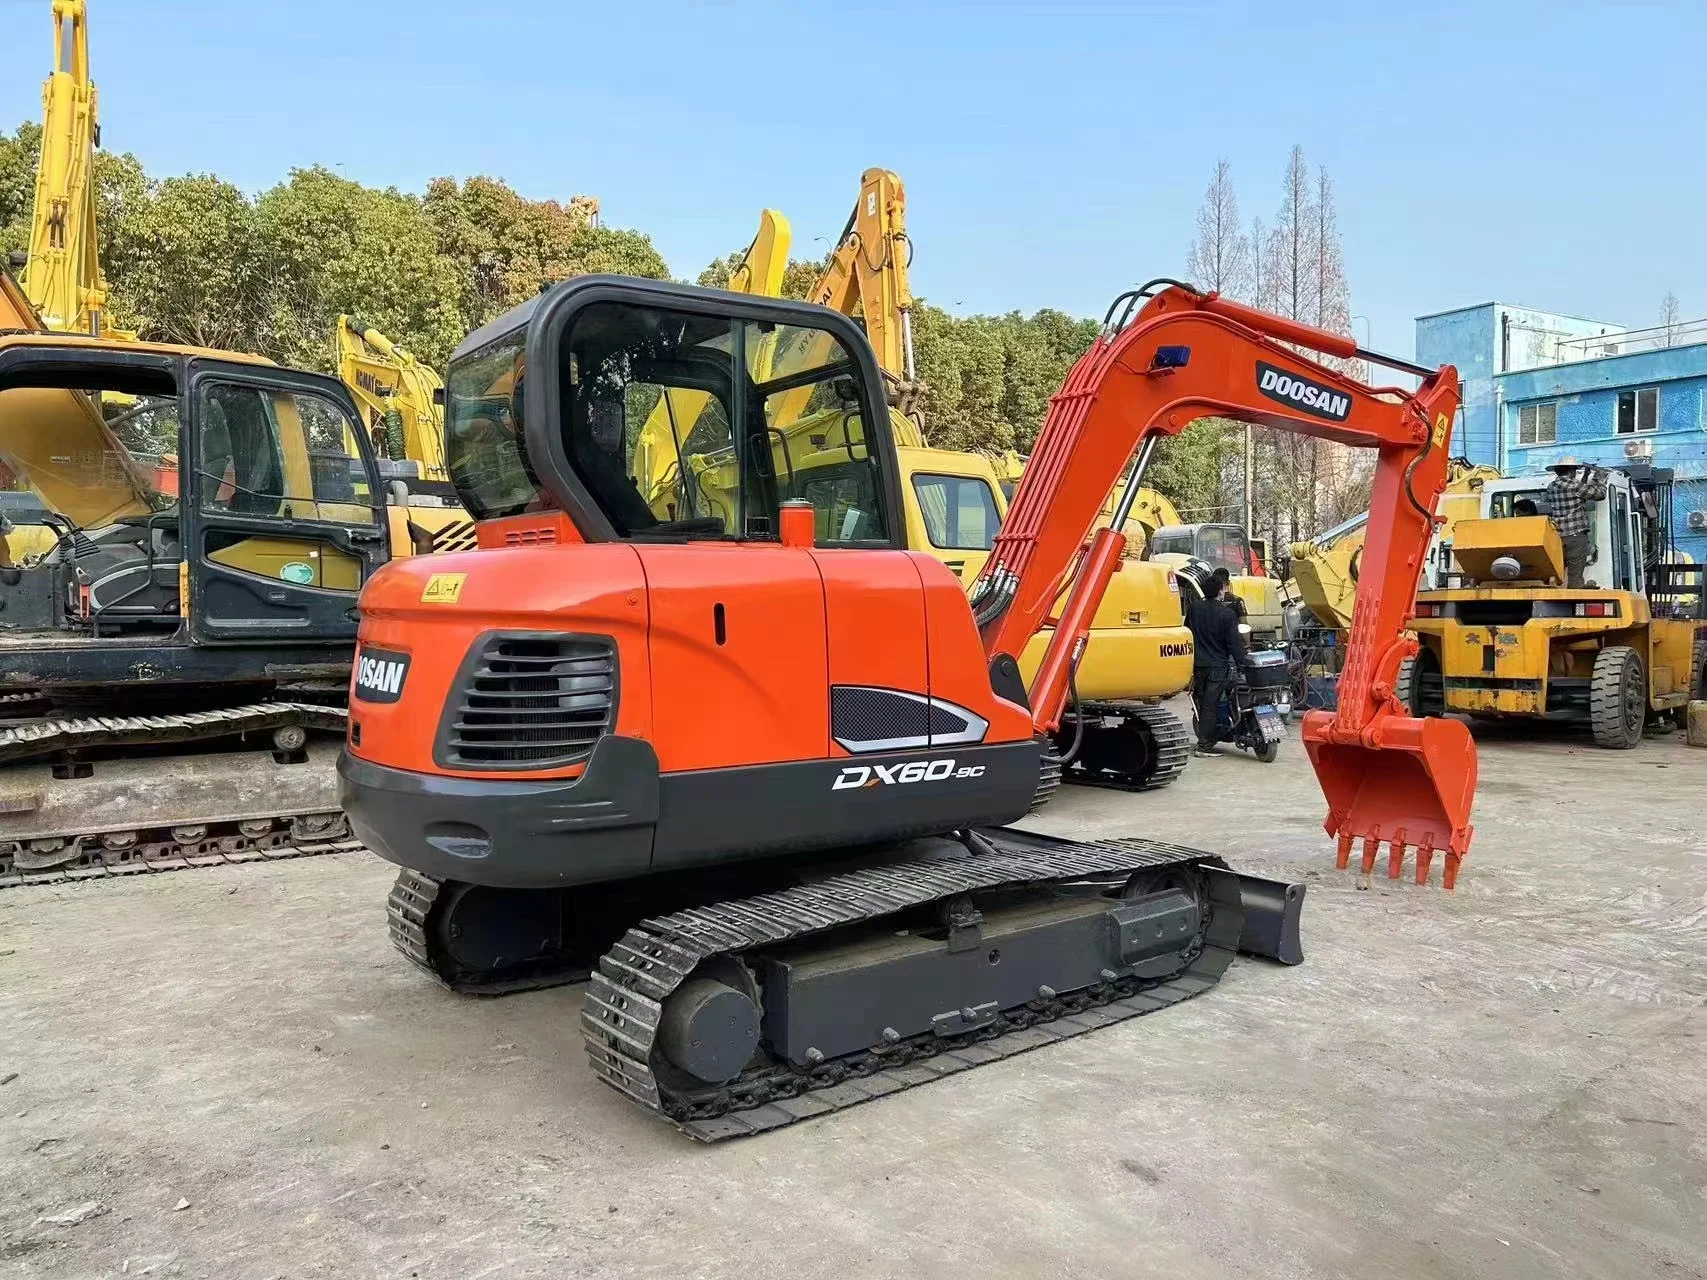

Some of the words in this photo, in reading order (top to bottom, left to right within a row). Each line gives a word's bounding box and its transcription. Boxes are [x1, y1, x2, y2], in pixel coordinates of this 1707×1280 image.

[798, 286, 832, 353] HYUAI
[1260, 369, 1348, 417] DOOSAN
[356, 655, 405, 694] OSAN
[832, 759, 986, 791] DX60-9C
